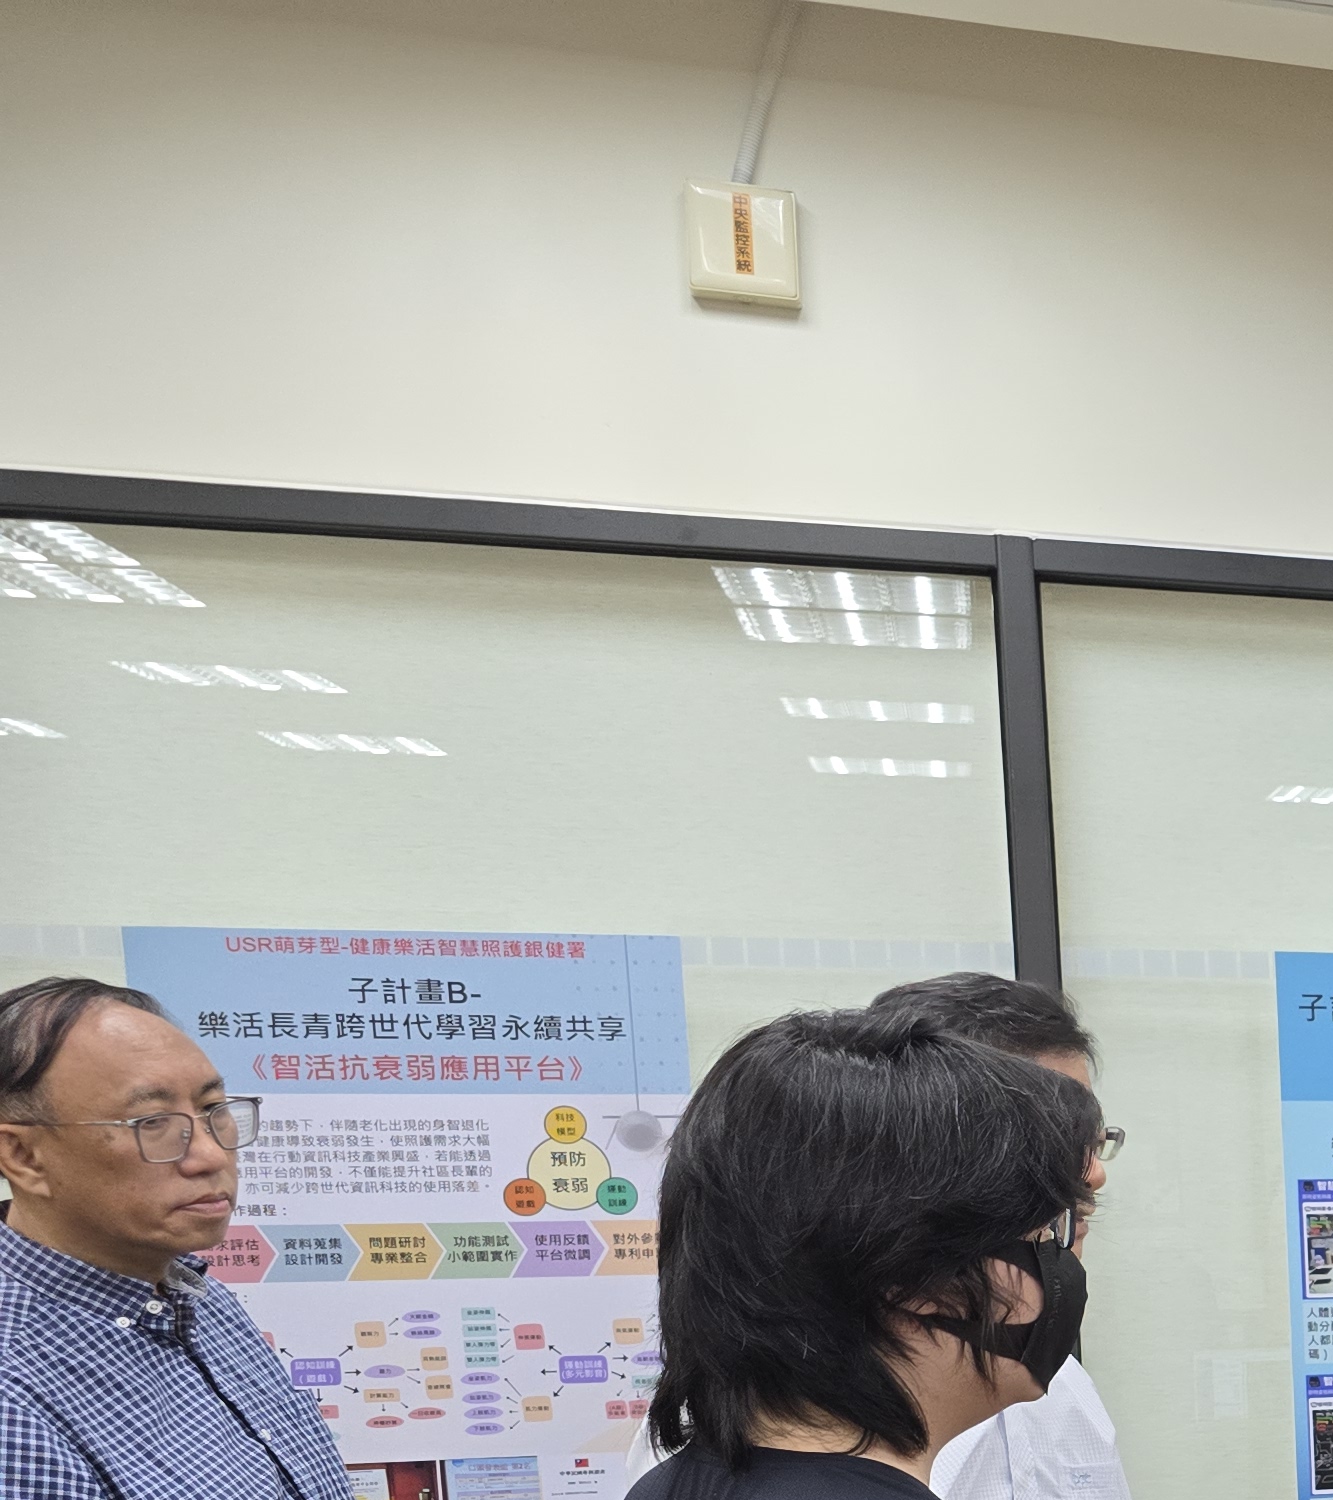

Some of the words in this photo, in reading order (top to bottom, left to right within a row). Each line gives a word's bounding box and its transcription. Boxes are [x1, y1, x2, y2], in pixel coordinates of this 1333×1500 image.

[733, 194, 752, 272] 中央監控系統
[225, 936, 587, 959] USR萌芽型-健康樂活智慧照護銀健署
[348, 977, 482, 1005] 子計畫B-
[198, 1011, 628, 1042] 樂活長青跨世代學習永續共享
[252, 1053, 585, 1083] 《智活抗衰弱應用平台》
[550, 1151, 587, 1167] 預防
[552, 1177, 589, 1193] 衰弱
[283, 1237, 343, 1250] 資料蒐集
[369, 1237, 426, 1249] 問題研討
[453, 1235, 510, 1247] 功能測試
[534, 1234, 590, 1246] 使用反饋
[285, 1253, 343, 1266] 設計開發
[370, 1251, 428, 1264] 專業整合
[447, 1250, 518, 1263] 小範圍實作
[535, 1248, 591, 1261] 平台微調
